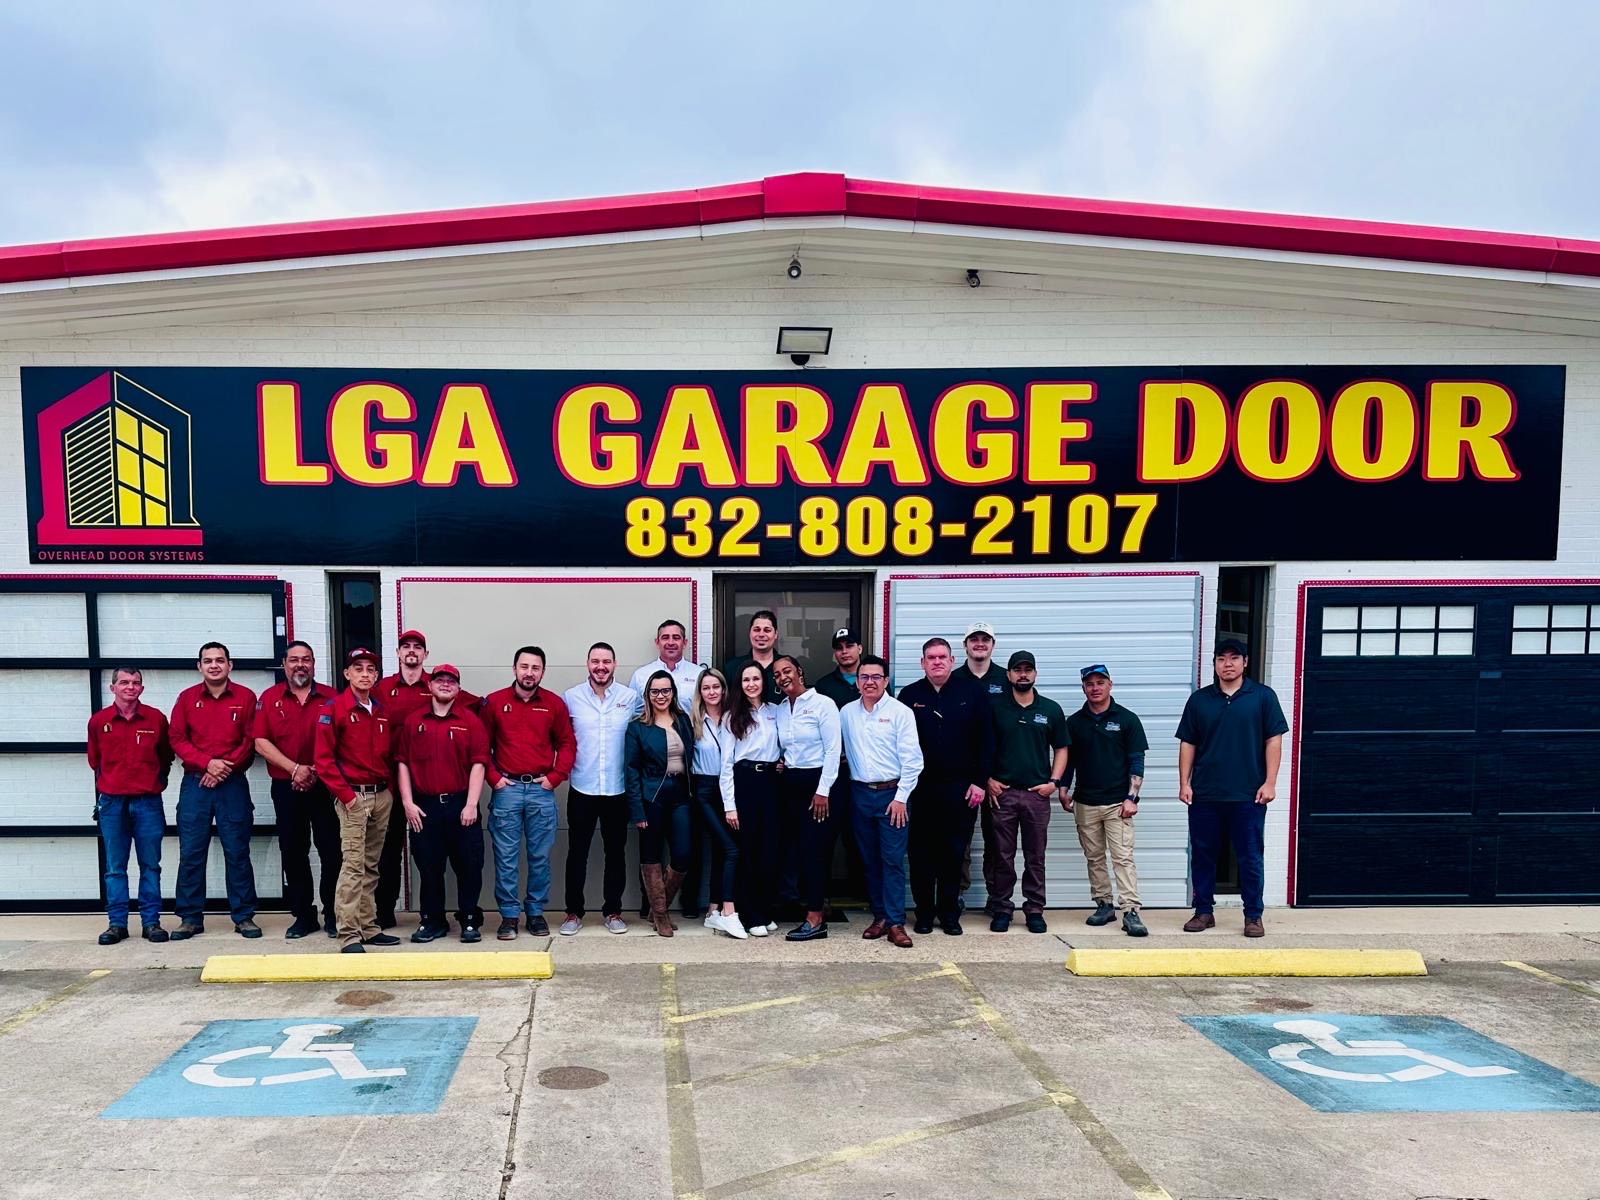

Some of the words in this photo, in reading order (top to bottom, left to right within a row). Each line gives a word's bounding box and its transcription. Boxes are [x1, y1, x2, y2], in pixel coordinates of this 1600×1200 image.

[257, 383, 518, 487] LGA
[552, 381, 1097, 489] GARAGE
[1137, 381, 1521, 483] DOOR
[38, 550, 105, 561] OVERHEAD
[109, 550, 145, 561] DOOR
[149, 550, 205, 561] SYSTEMS
[625, 493, 1158, 558] 832-808-2107
